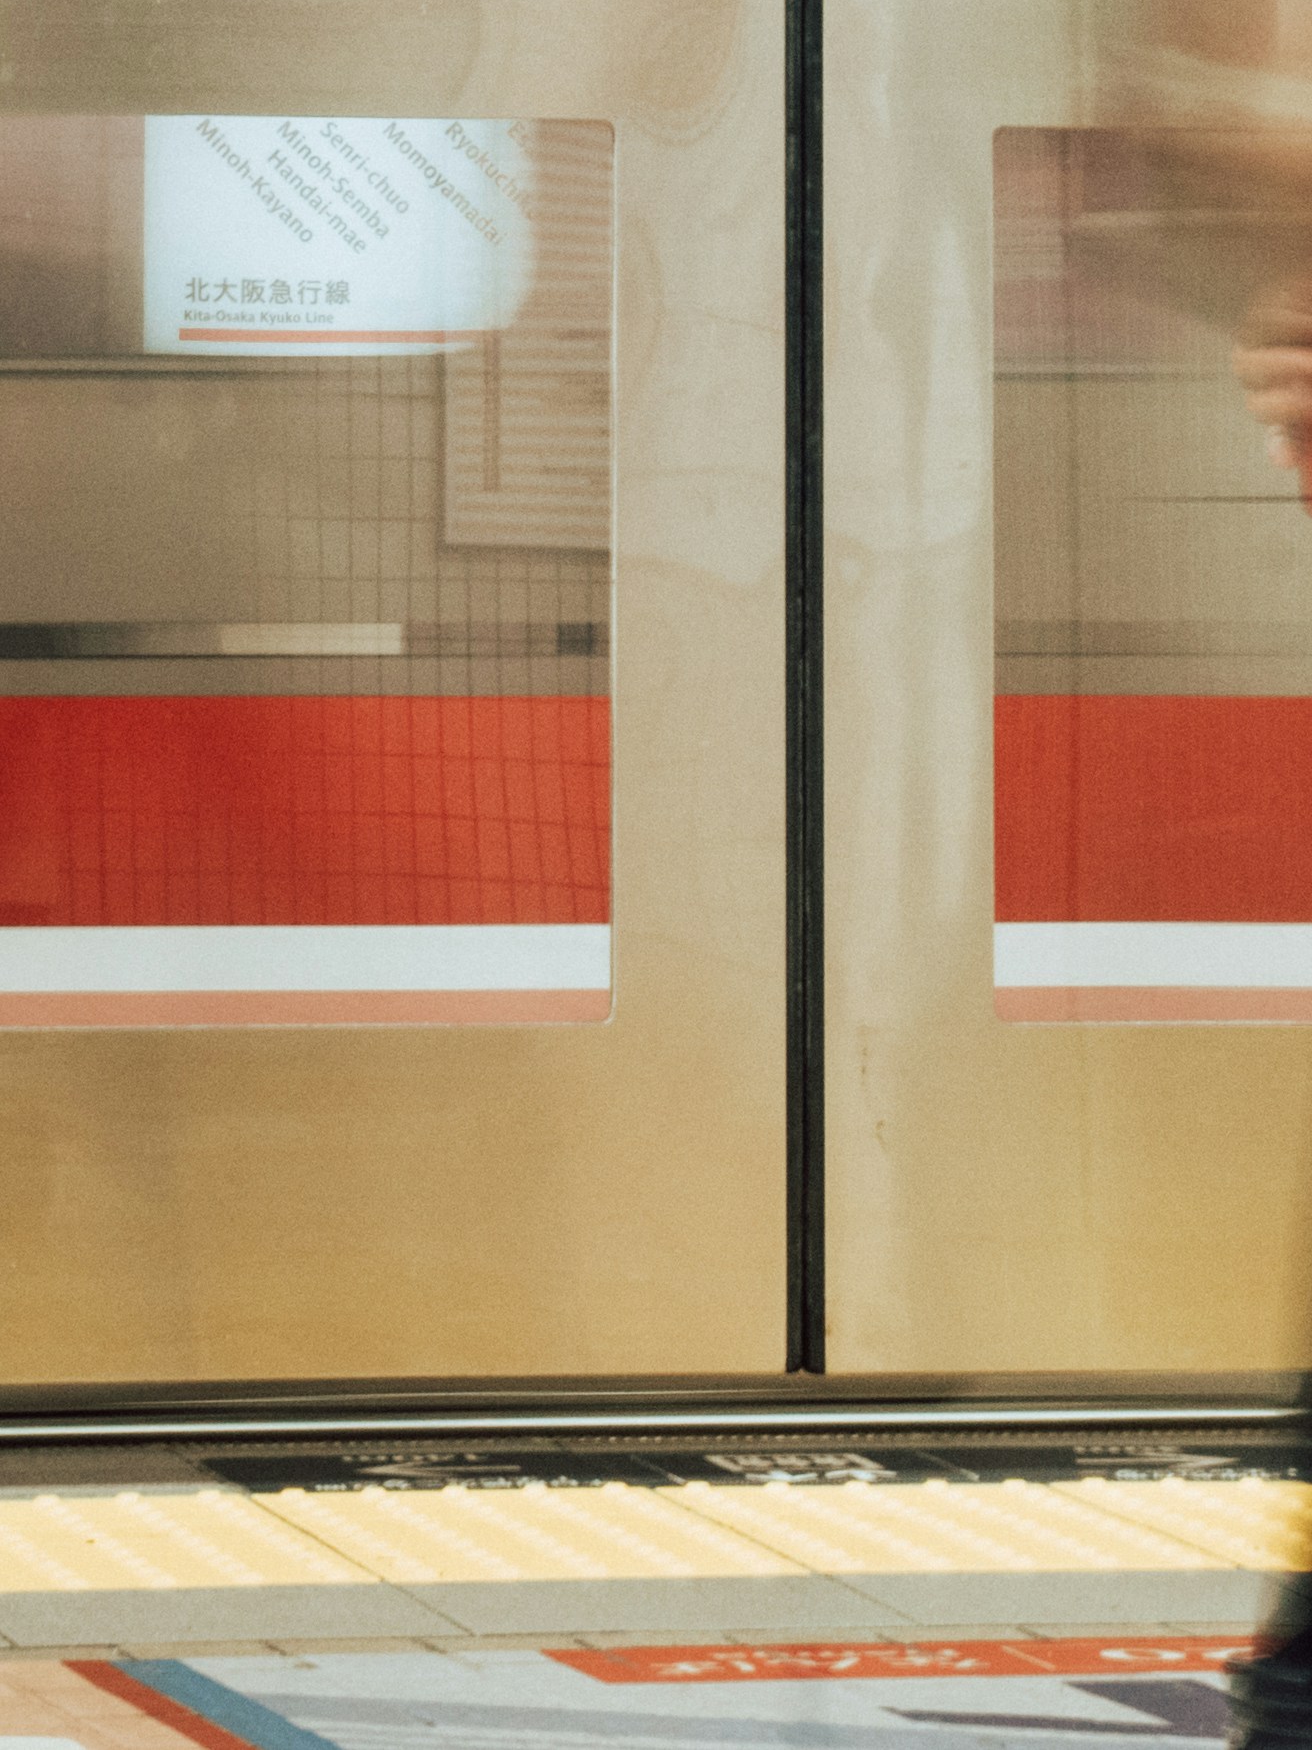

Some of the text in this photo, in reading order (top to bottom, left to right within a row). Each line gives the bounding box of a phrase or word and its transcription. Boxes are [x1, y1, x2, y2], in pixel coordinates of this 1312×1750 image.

[196, 119, 313, 244] Minoh-Kayano
[267, 149, 366, 255] Handai-mae
[276, 121, 390, 240] Minoh-Semba
[319, 122, 410, 216] Senri-chuo
[383, 122, 508, 247] Momoyamadai
[184, 309, 334, 326] Kita-Osaka Kyuko Line
[185, 277, 350, 305] 北大阪急行線
